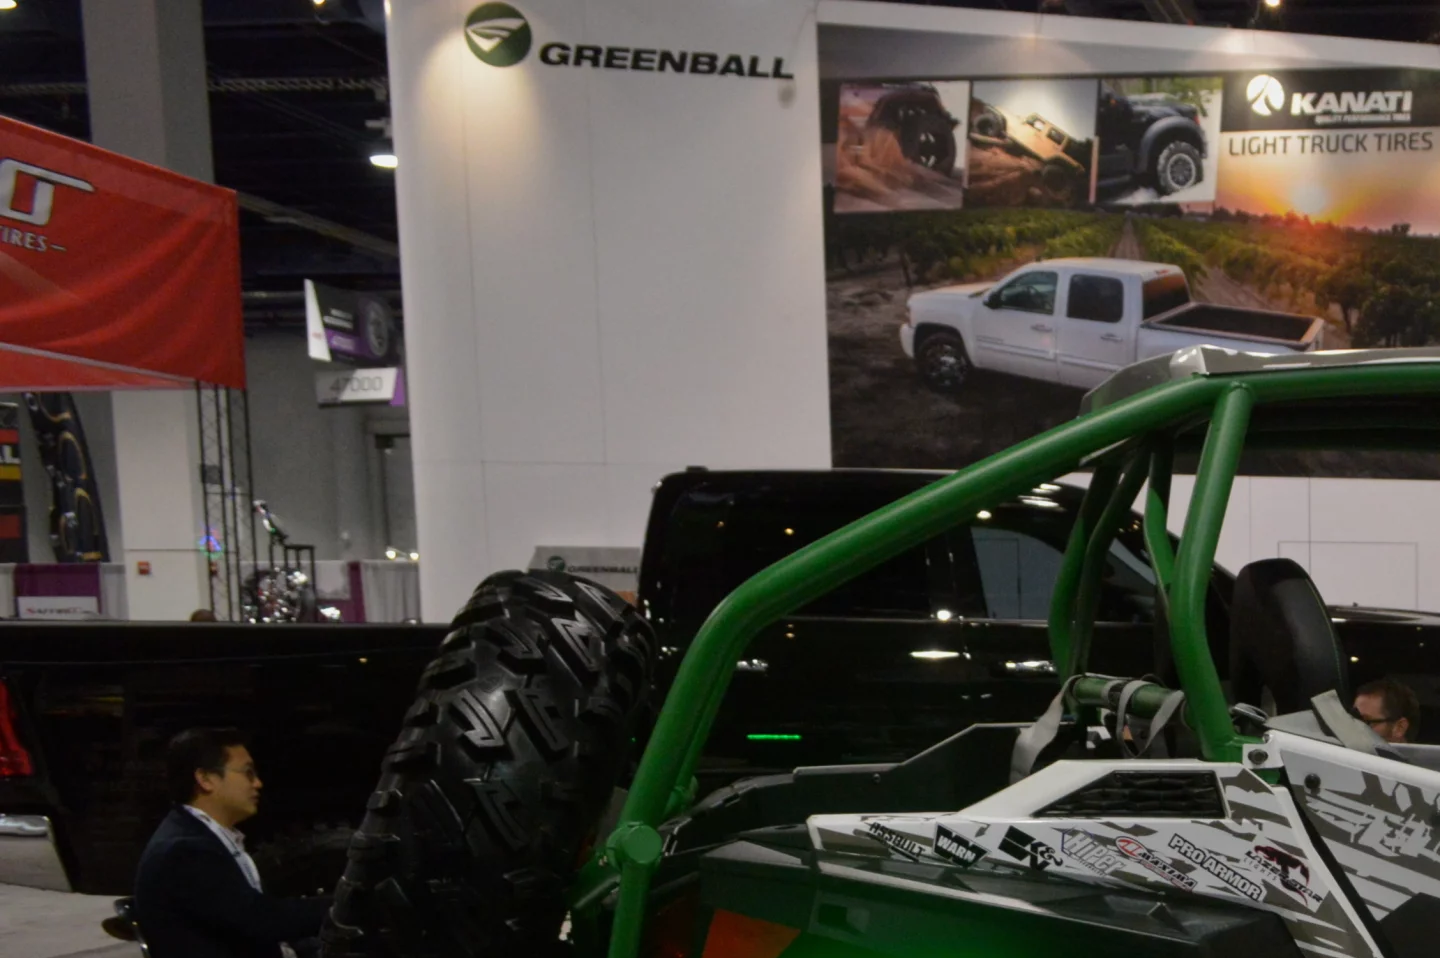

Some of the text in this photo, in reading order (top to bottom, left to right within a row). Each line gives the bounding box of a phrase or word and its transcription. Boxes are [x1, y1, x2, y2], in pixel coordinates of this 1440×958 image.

[539, 43, 794, 79] GREENBALL
[1290, 91, 1413, 116] KANATI
[1229, 131, 1433, 156] LIGHT TRUCK TIRES
[330, 376, 383, 393] 47000
[937, 835, 976, 863] WARN
[1138, 851, 1197, 888] MAXIMA
[1169, 835, 1207, 865] PRO
[1201, 856, 1262, 901] ARMOR
